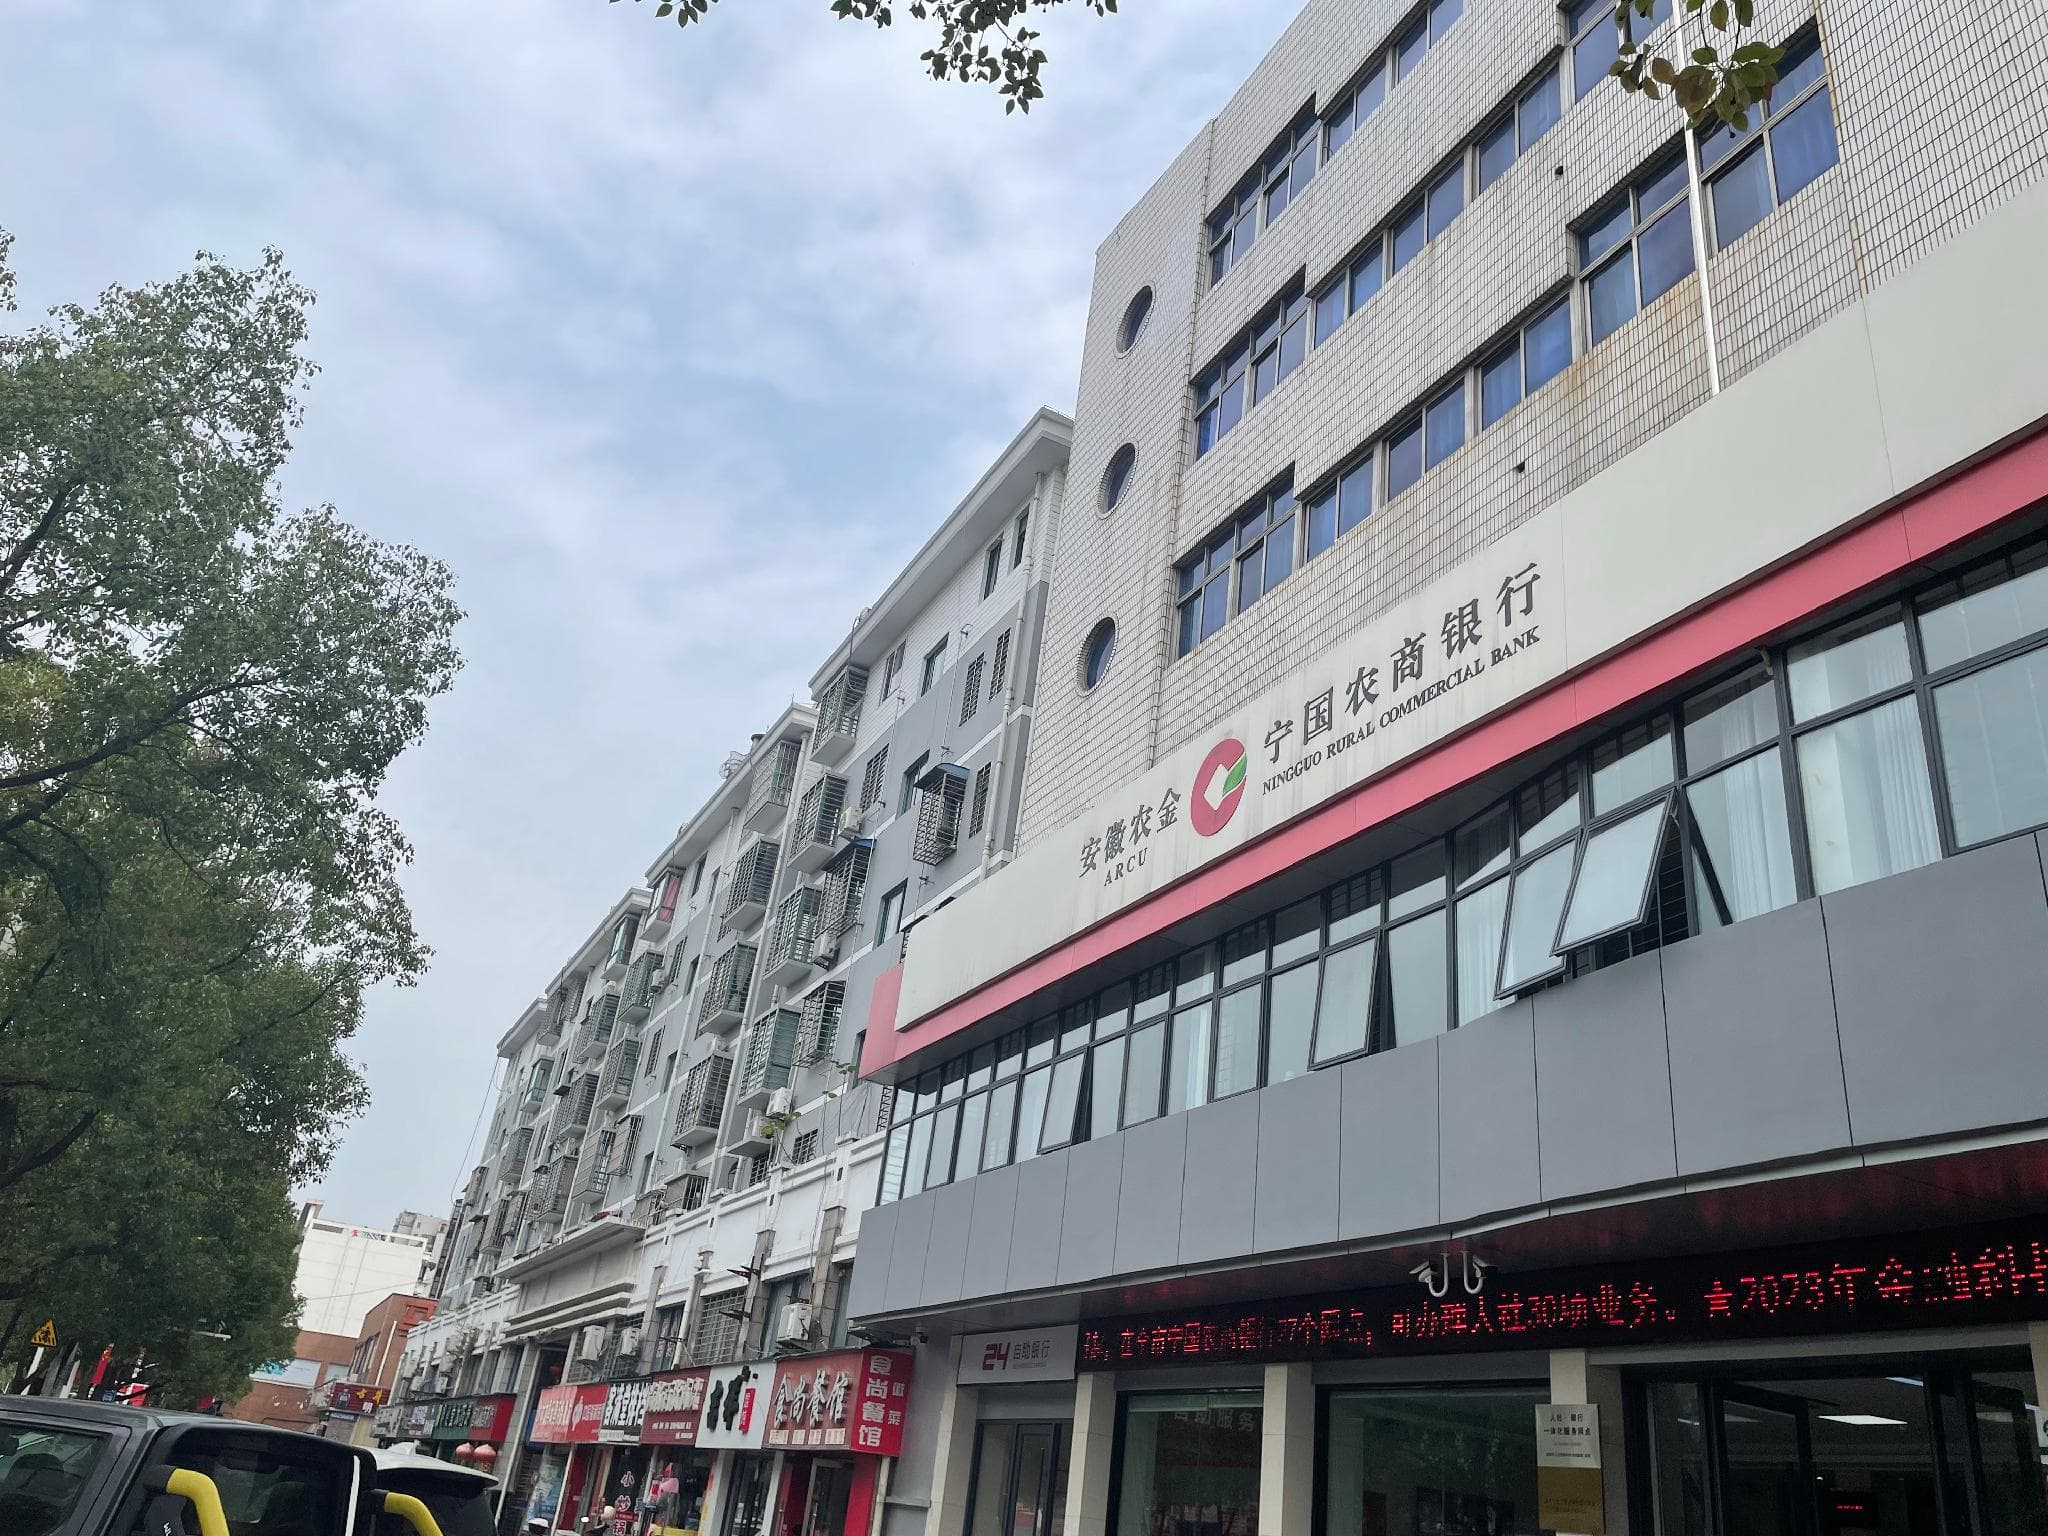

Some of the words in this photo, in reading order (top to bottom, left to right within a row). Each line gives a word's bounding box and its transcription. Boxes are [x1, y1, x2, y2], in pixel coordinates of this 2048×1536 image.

[1263, 562, 1541, 763] 宁国农商银行
[1262, 750, 1322, 796] NINGGUO
[1326, 721, 1376, 759] RURAL
[1379, 659, 1485, 729] COMMERCIAL
[1490, 625, 1540, 666] BANK
[1079, 787, 1182, 878] 安徽农金
[1103, 847, 1149, 887] ARCU
[773, 1368, 850, 1429] 食尚餐馆
[982, 1342, 1011, 1371] 24
[1013, 1338, 1053, 1361] 自动银行
[858, 1355, 892, 1447] 食尚餐馆
